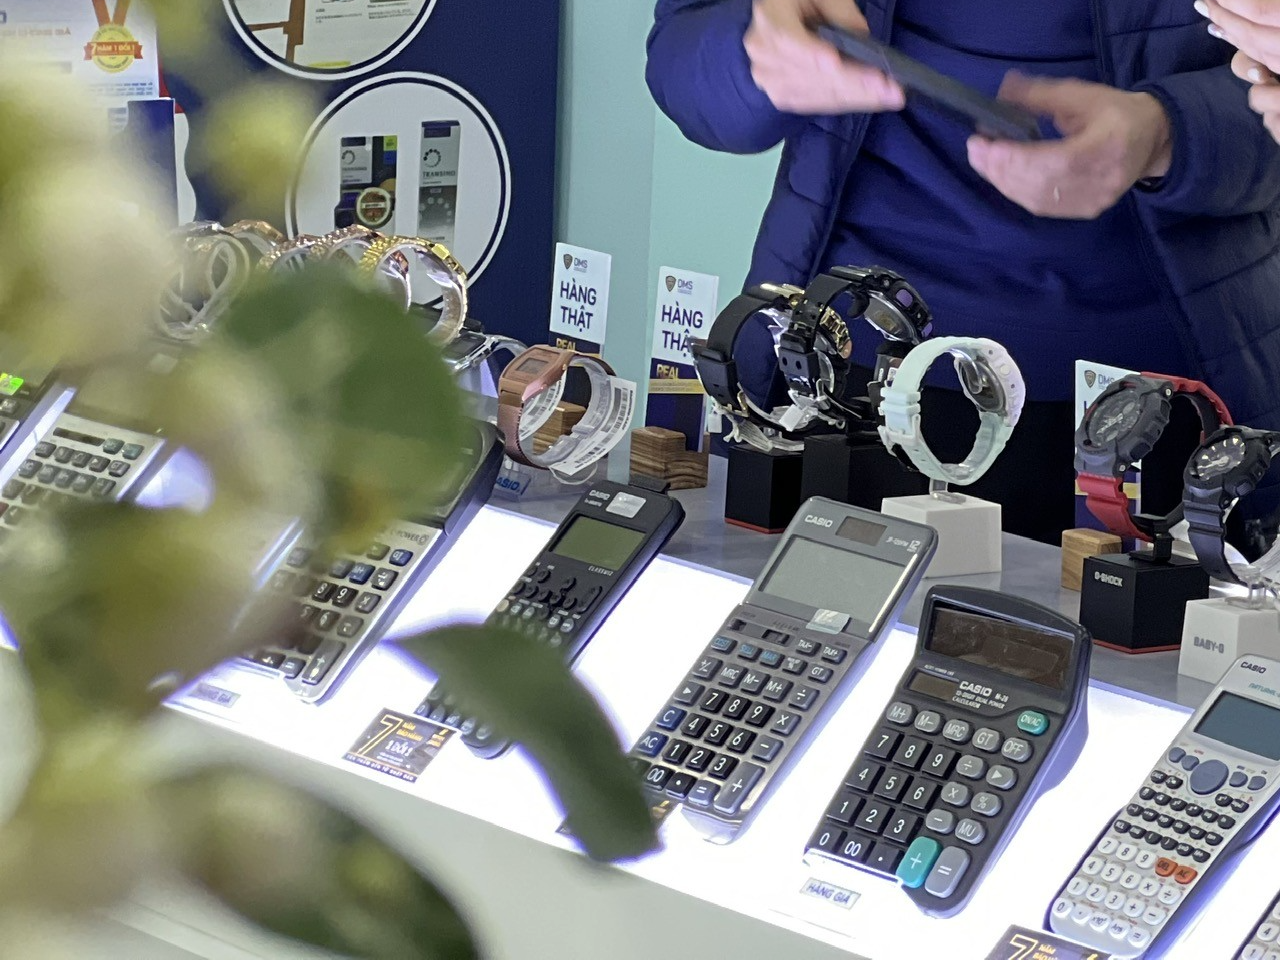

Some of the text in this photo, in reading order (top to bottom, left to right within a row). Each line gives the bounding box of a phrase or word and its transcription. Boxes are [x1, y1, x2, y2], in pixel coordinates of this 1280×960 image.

[422, 170, 456, 178] TRANSINO
[560, 276, 597, 306] HÀNG
[678, 278, 694, 291] DMS
[560, 304, 593, 334] THẬT
[662, 301, 703, 328] HÀNG
[662, 328, 691, 357] THẬ
[804, 514, 833, 528] CASIO
[1094, 572, 1123, 588] G-SHOCK
[339, 587, 348, 602] 9
[722, 667, 739, 679] MRC
[766, 681, 782, 692] M+
[811, 666, 824, 676] GT
[1240, 662, 1266, 674] CASIO
[959, 680, 992, 696] CASIO
[706, 692, 763, 718] 7 8 9
[952, 696, 980, 709] CALCULATOR
[989, 698, 1005, 710] POWER
[357, 714, 403, 756] 7
[663, 710, 742, 746] C 4 5 6
[890, 706, 1042, 744] M+ M- MRC GT ON/AC
[641, 736, 726, 771] AC 1 2 3
[876, 735, 1024, 767] 7 8 9 OFF
[648, 768, 664, 782] 00
[858, 768, 869, 780] 4
[886, 776, 897, 790] 5
[914, 786, 924, 800] 6
[840, 802, 976, 837] 1 2 3 MU
[820, 832, 861, 856] 0 00
[1104, 840, 1189, 878] 7 8 9 DEL AC
[1087, 860, 1132, 884] 4 5 6
[1073, 881, 1118, 904] 1 2 3
[1056, 902, 1065, 912] 0
[1264, 928, 1272, 936] 4
[1251, 949, 1256, 957] 1
